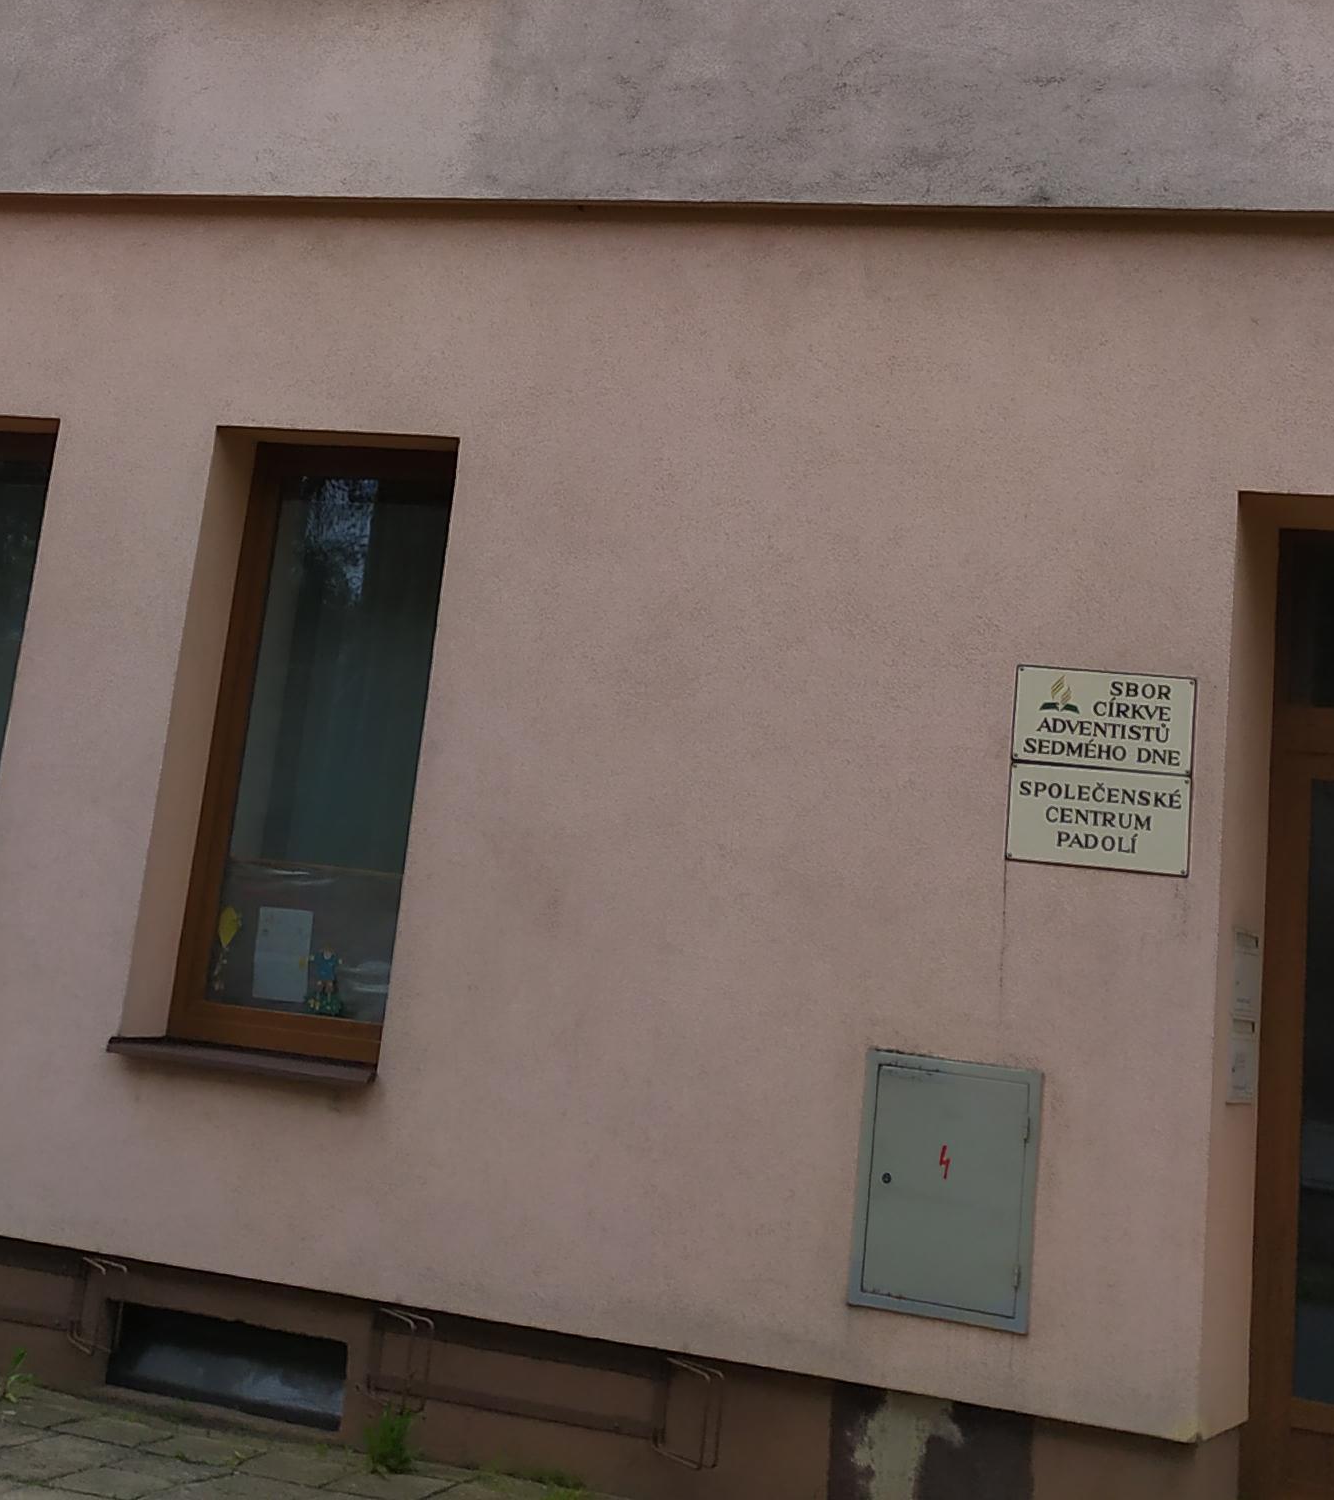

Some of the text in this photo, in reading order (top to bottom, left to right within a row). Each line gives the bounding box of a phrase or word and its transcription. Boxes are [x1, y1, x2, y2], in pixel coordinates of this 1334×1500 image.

[1110, 681, 1171, 700] SBOR
[1093, 697, 1171, 722] CÍRKVE
[1036, 718, 1169, 743] ADVENTISTŮ
[1023, 738, 1180, 766] SEDMÉHO DNE
[1019, 781, 1182, 809] SPOLEČENSKÉ
[1045, 806, 1151, 831] CENTRUM
[1056, 831, 1138, 853] PADOLÍ
